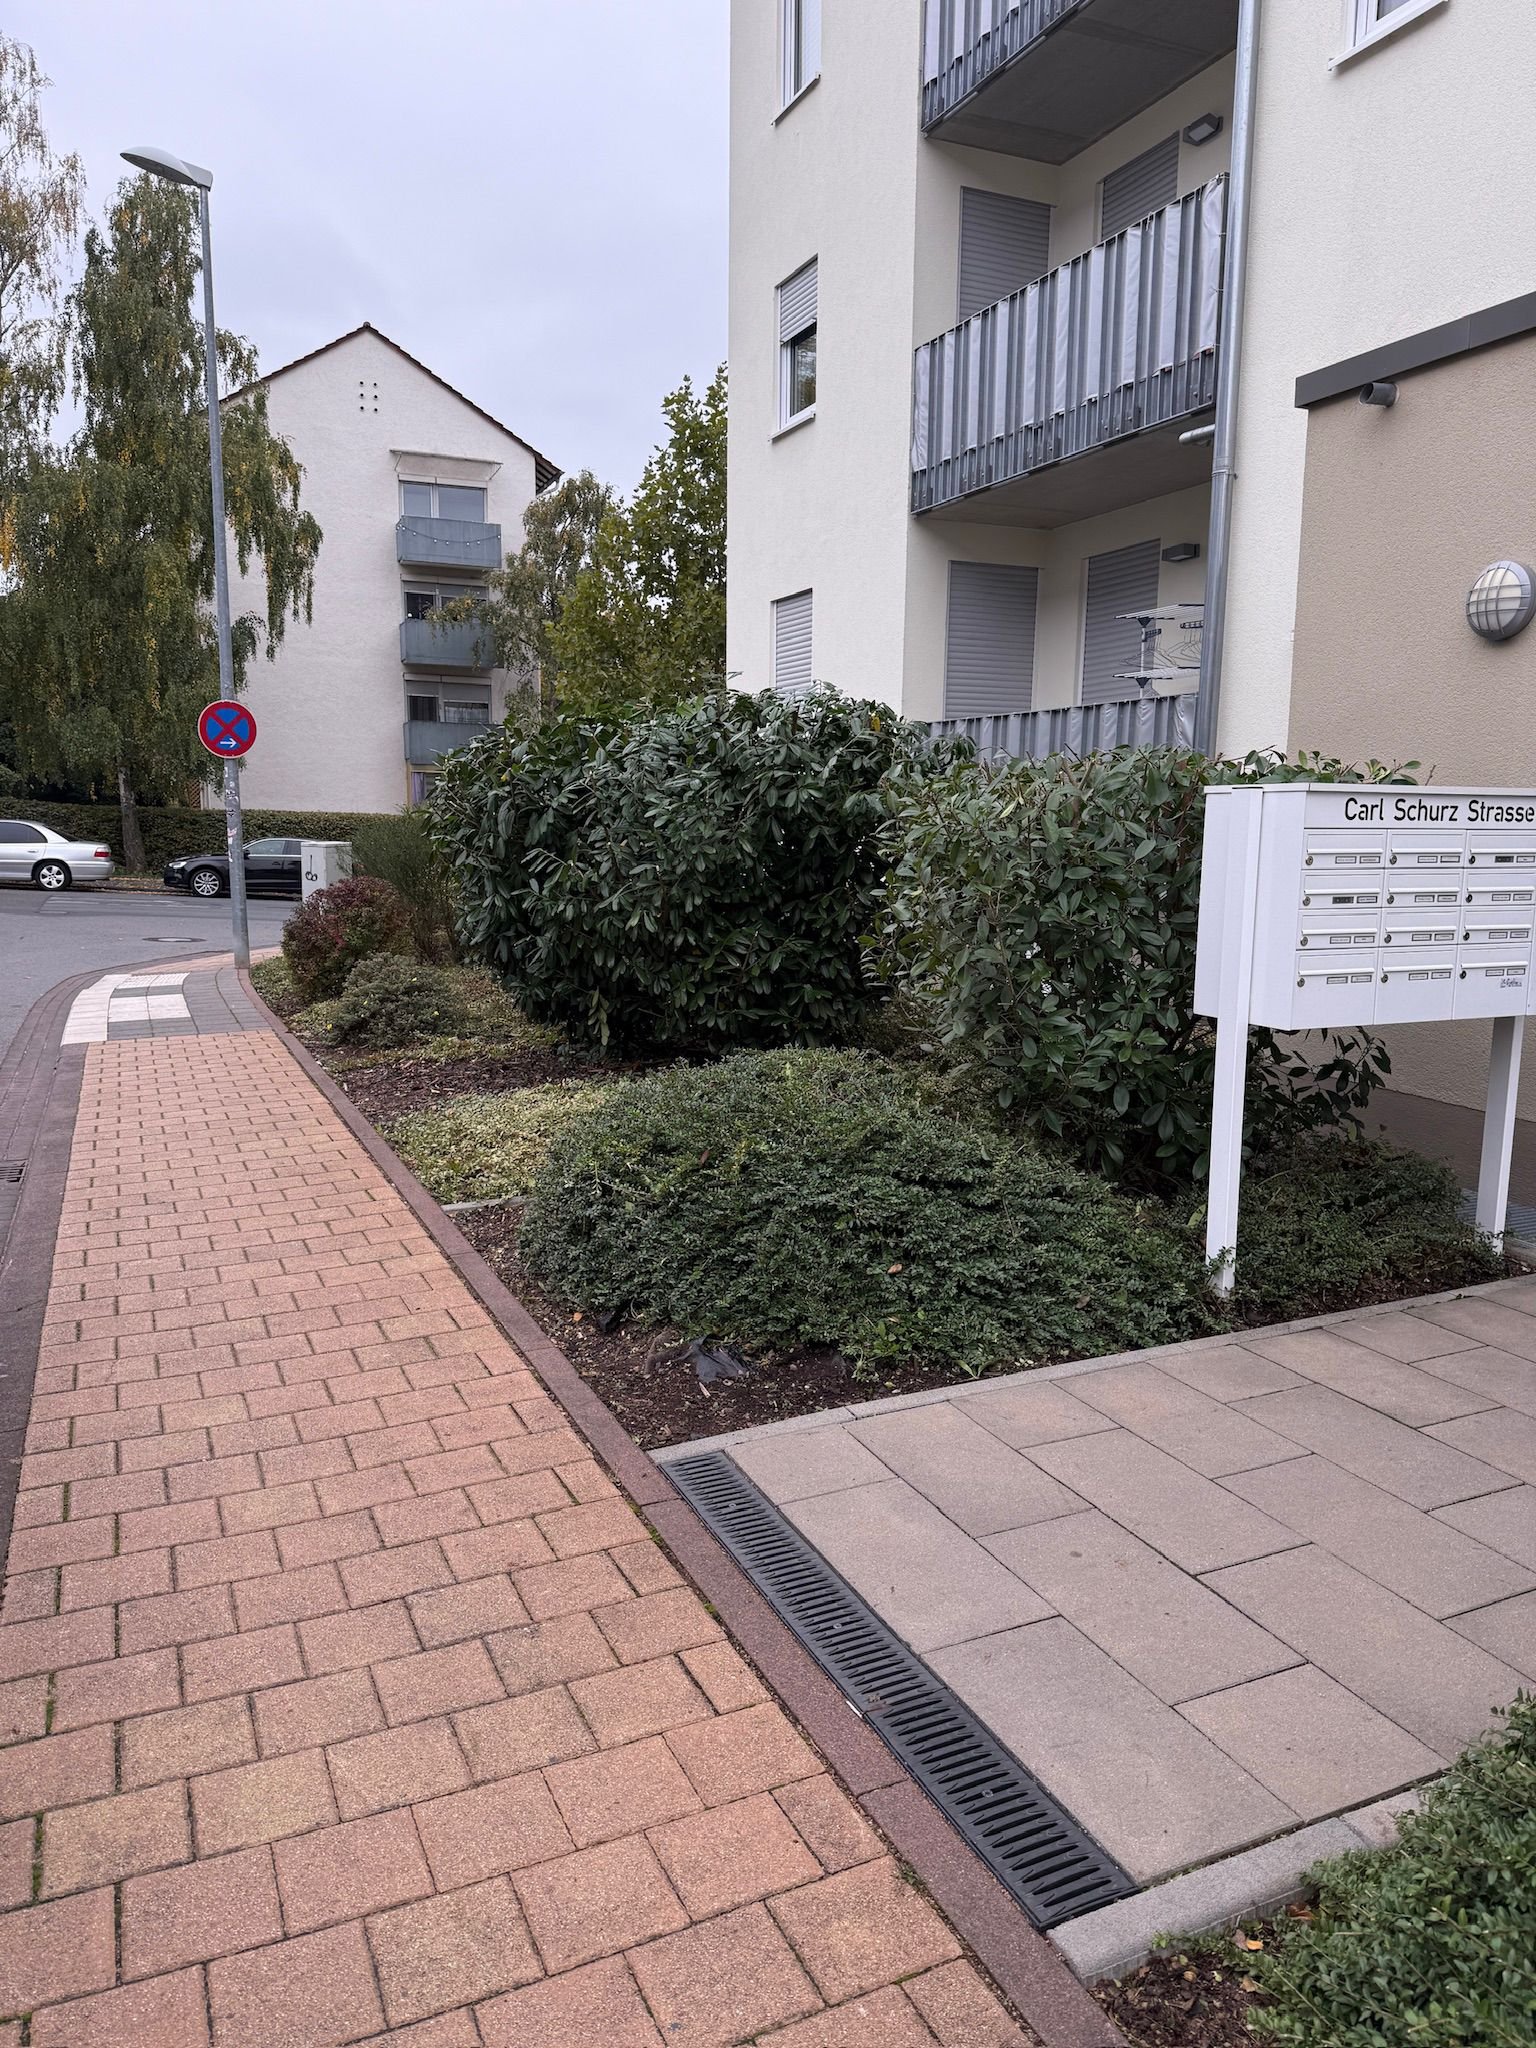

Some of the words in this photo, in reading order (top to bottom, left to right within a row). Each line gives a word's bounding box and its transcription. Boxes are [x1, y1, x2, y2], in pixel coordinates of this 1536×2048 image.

[1344, 797, 1384, 821] Carl
[1393, 798, 1459, 822] Schurz
[1467, 799, 1535, 823] Strasse
